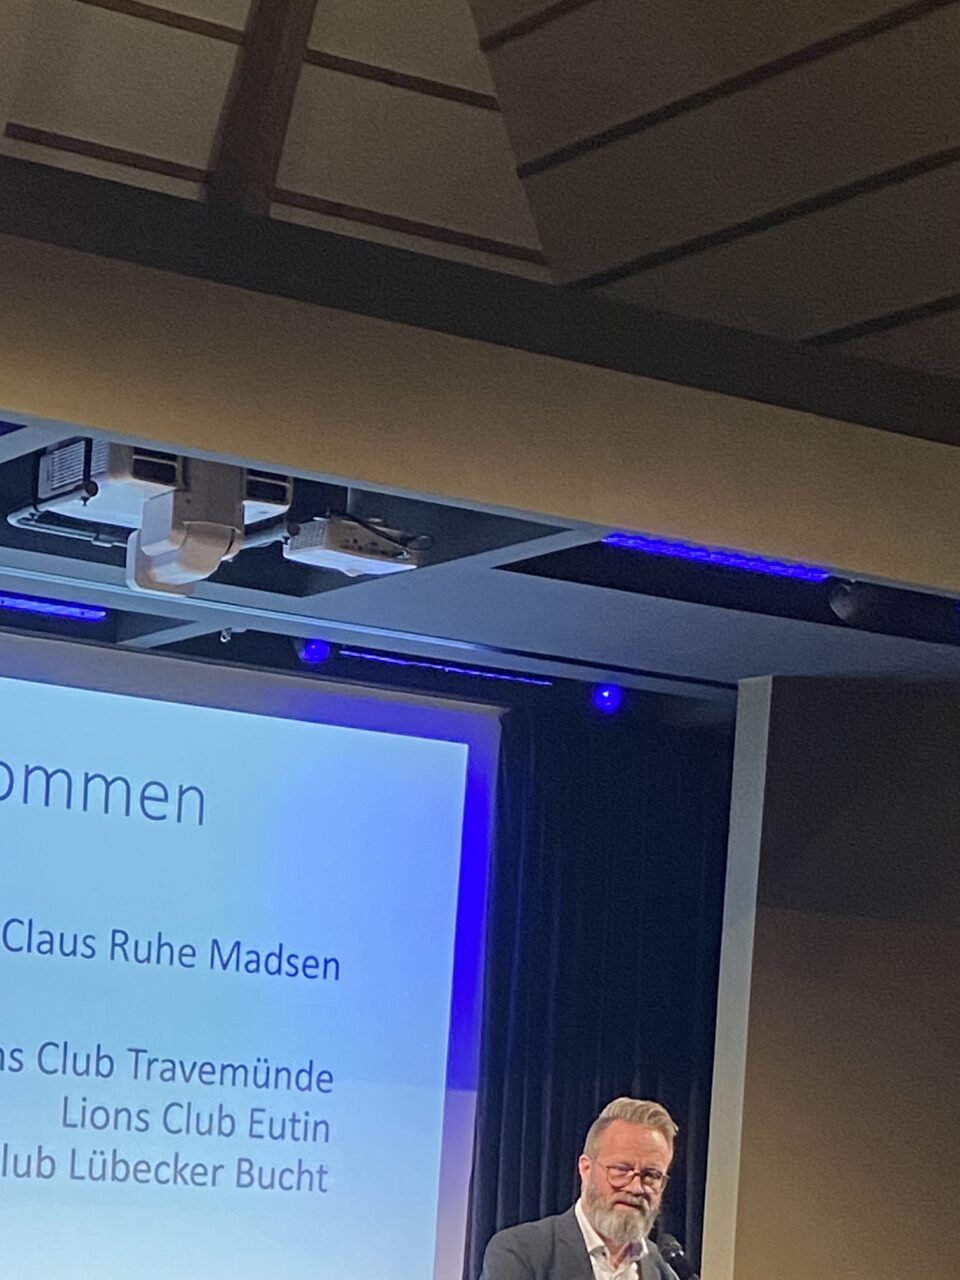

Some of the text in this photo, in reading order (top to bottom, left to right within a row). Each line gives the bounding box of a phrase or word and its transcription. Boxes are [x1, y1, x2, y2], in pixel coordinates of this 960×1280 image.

[1, 918, 97, 961] Claus
[109, 928, 197, 969] Ruhe
[209, 938, 341, 982] Madsen
[37, 1040, 115, 1079] Club
[126, 1047, 335, 1094] Travemünde
[61, 1095, 331, 1143] Lions Club Eutin
[69, 1147, 225, 1187] Lübecker
[235, 1157, 330, 1194] Bucht
